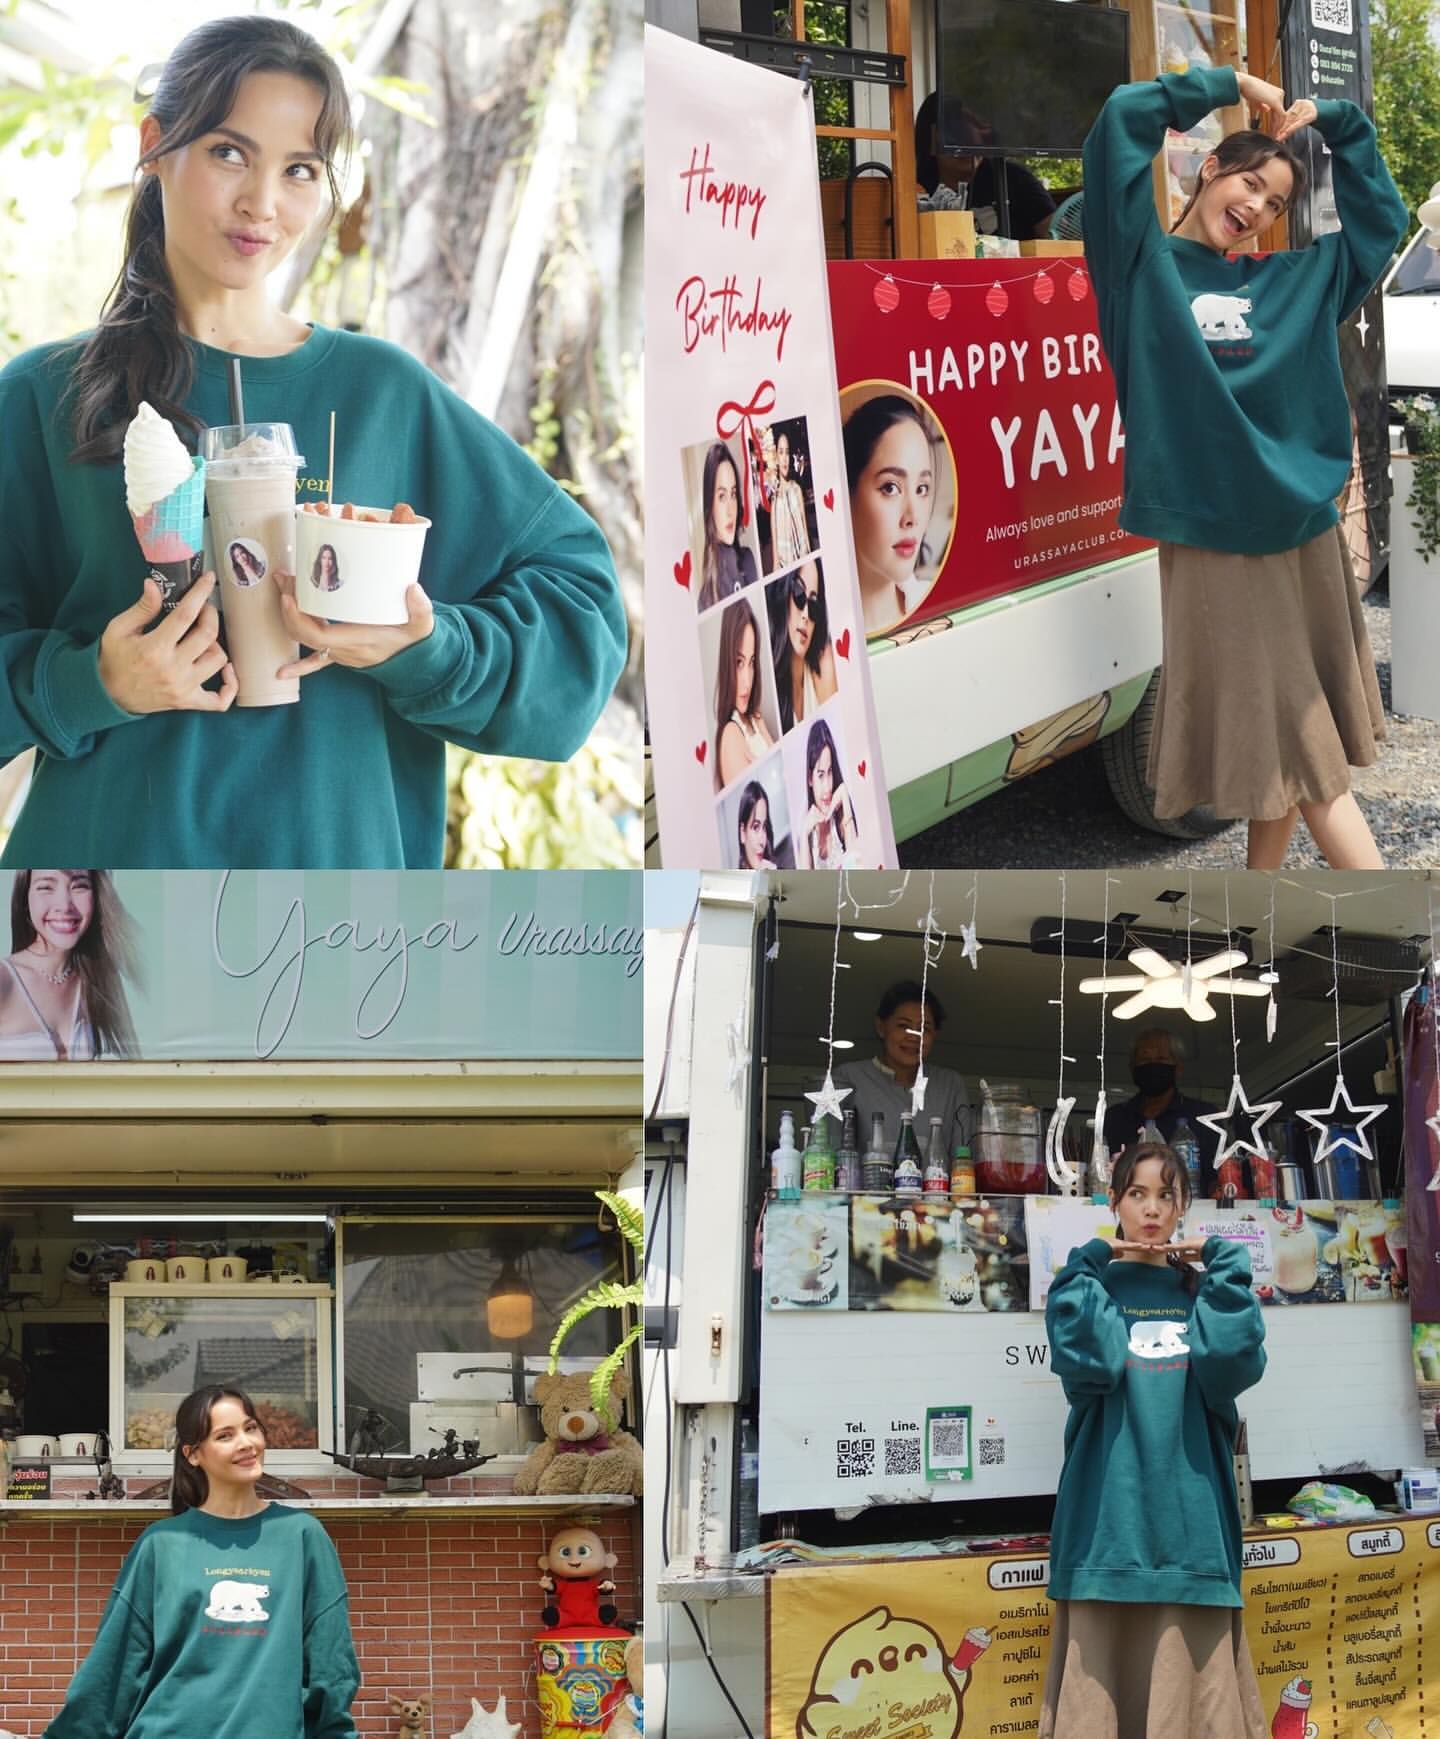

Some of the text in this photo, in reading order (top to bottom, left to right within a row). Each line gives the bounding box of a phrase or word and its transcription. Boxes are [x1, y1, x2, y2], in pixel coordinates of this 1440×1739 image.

[680, 142, 767, 240] Happy
[676, 274, 792, 363] Birthday
[909, 340, 1029, 396] HAPPY
[985, 495, 1122, 542] Always love and support
[213, 870, 479, 1058] Yaya
[845, 1420, 920, 1433] Tel. Line.
[1361, 1531, 1391, 1552] สมูทตี้
[1002, 1564, 1044, 1584] กาแฟ
[1010, 1692, 1034, 1707] ลาเต้
